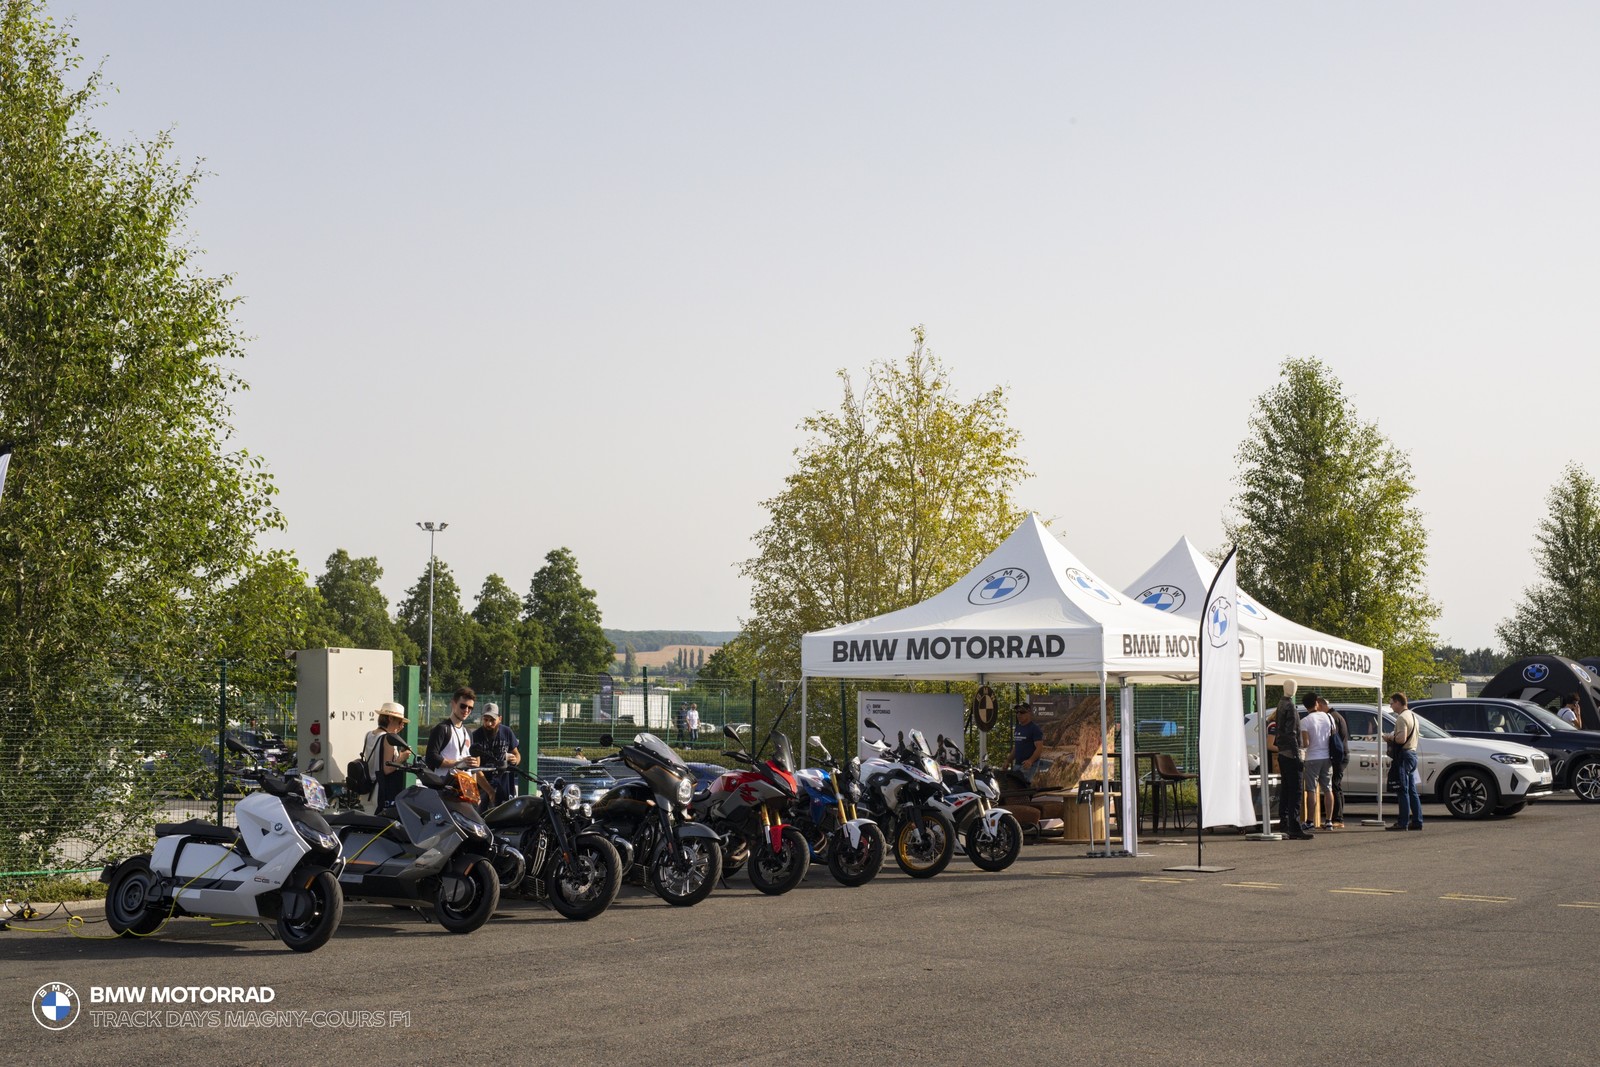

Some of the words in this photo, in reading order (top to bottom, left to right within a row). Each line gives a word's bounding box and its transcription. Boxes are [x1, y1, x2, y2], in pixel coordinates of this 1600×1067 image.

[985, 569, 1025, 583] BMW
[1143, 587, 1181, 598] BMW
[832, 638, 898, 663] BMW
[906, 634, 1066, 661] MOTORRAD
[1122, 634, 1161, 658] BMW
[1277, 641, 1307, 664] BMW
[1310, 645, 1371, 674] MOTORRAD
[341, 711, 364, 721] PST
